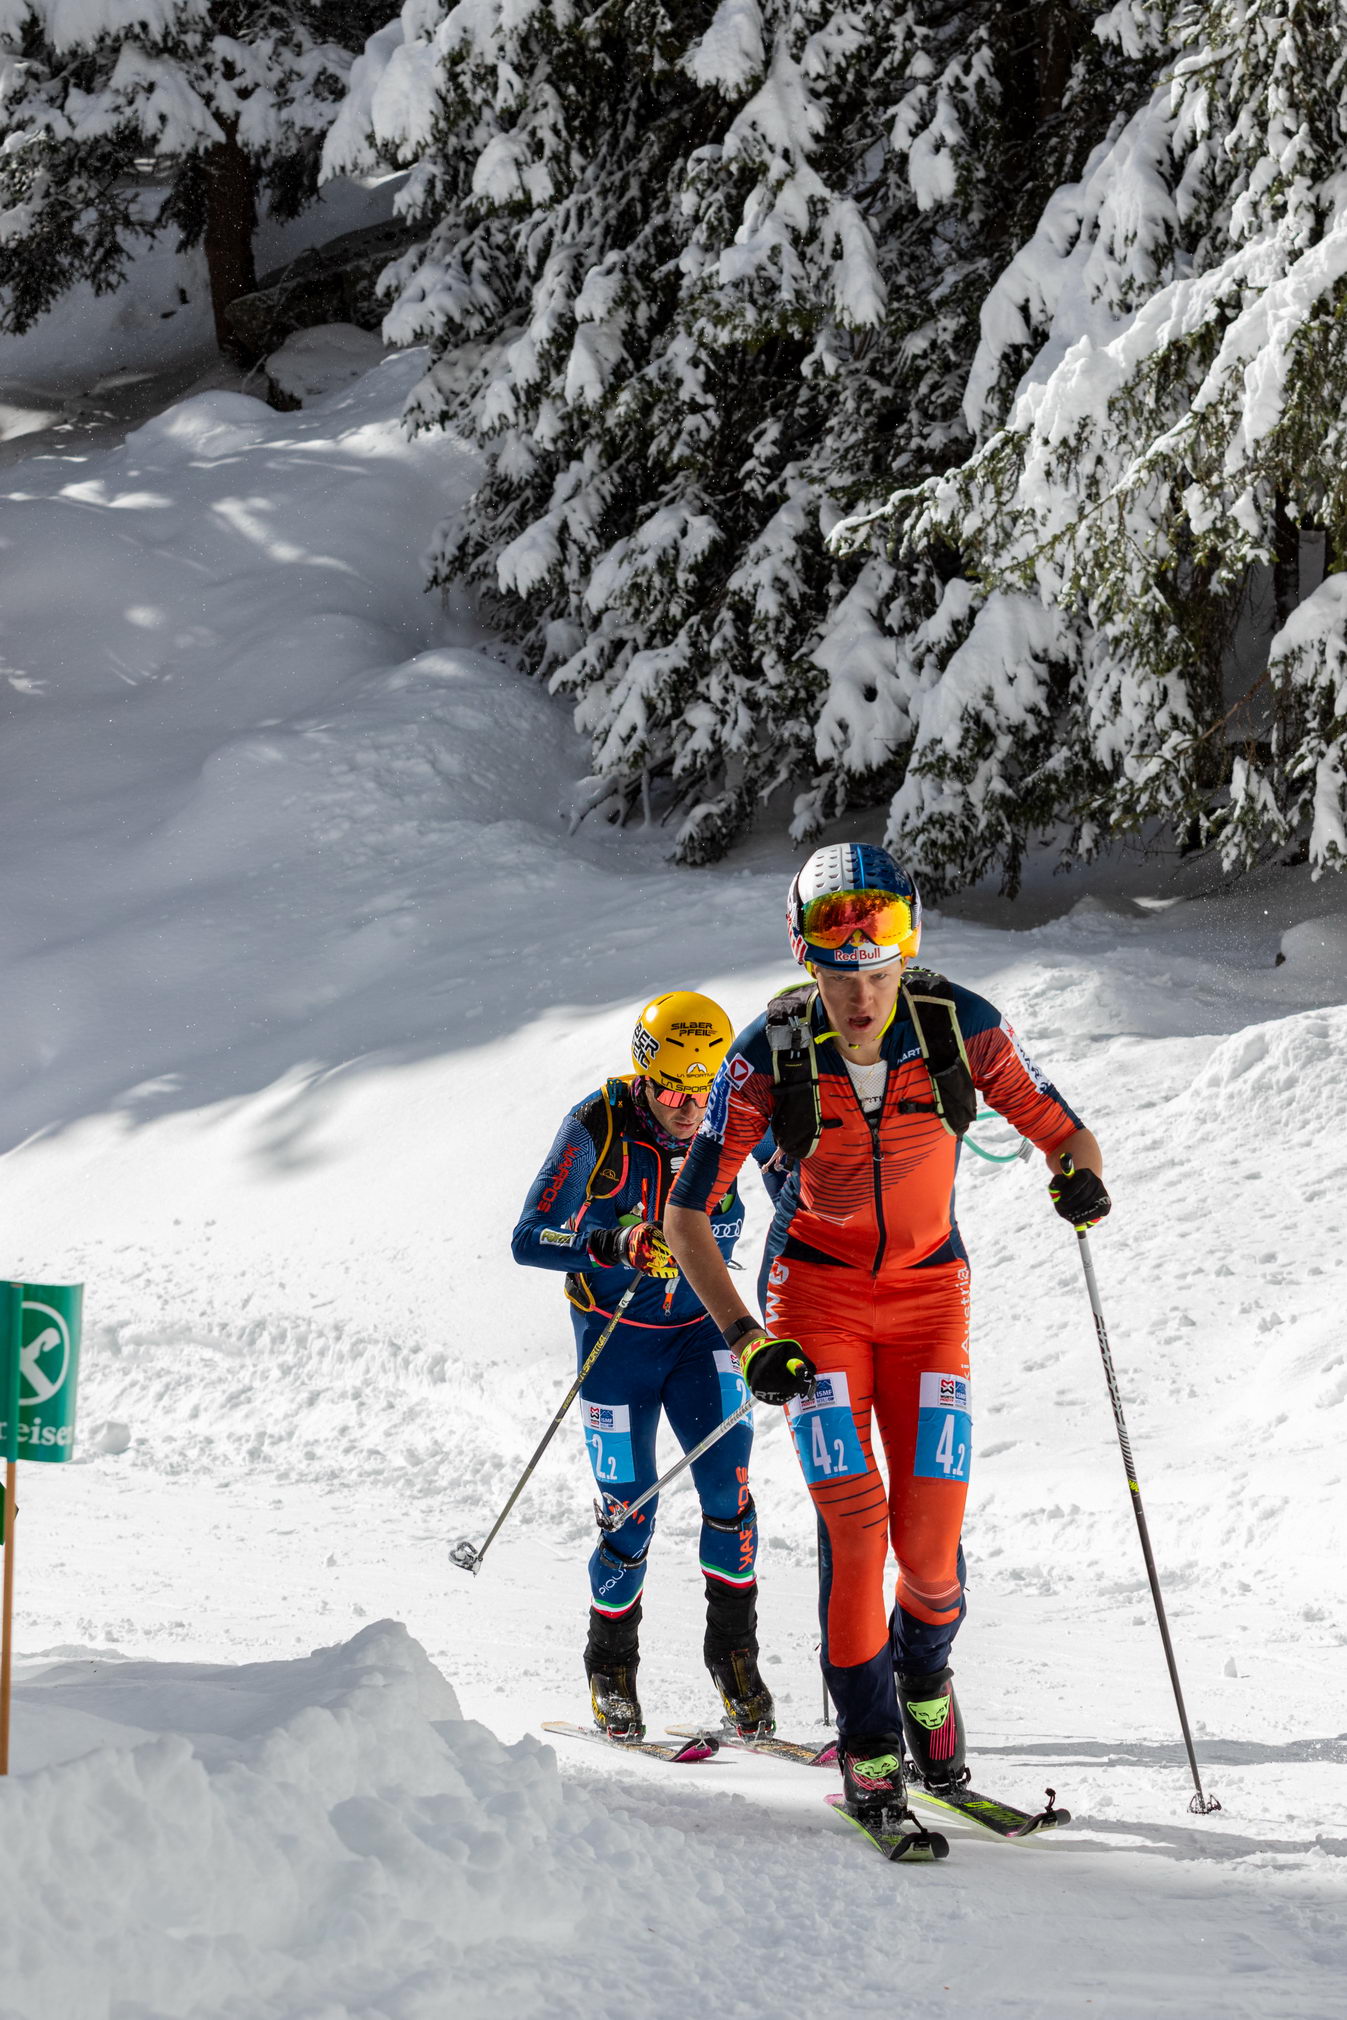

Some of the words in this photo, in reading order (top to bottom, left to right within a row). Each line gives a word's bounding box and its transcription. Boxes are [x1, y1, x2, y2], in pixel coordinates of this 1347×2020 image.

[834, 949, 858, 961] Red
[858, 947, 881, 960] Bull
[671, 1022, 713, 1031] SILBER
[679, 1029, 712, 1037] PFEIL
[660, 1078, 674, 1089] LA
[816, 1389, 833, 1398] ISMF
[811, 1415, 849, 1475] 4.2
[935, 1413, 966, 1477] 4.2
[592, 1433, 618, 1480] 2.2
